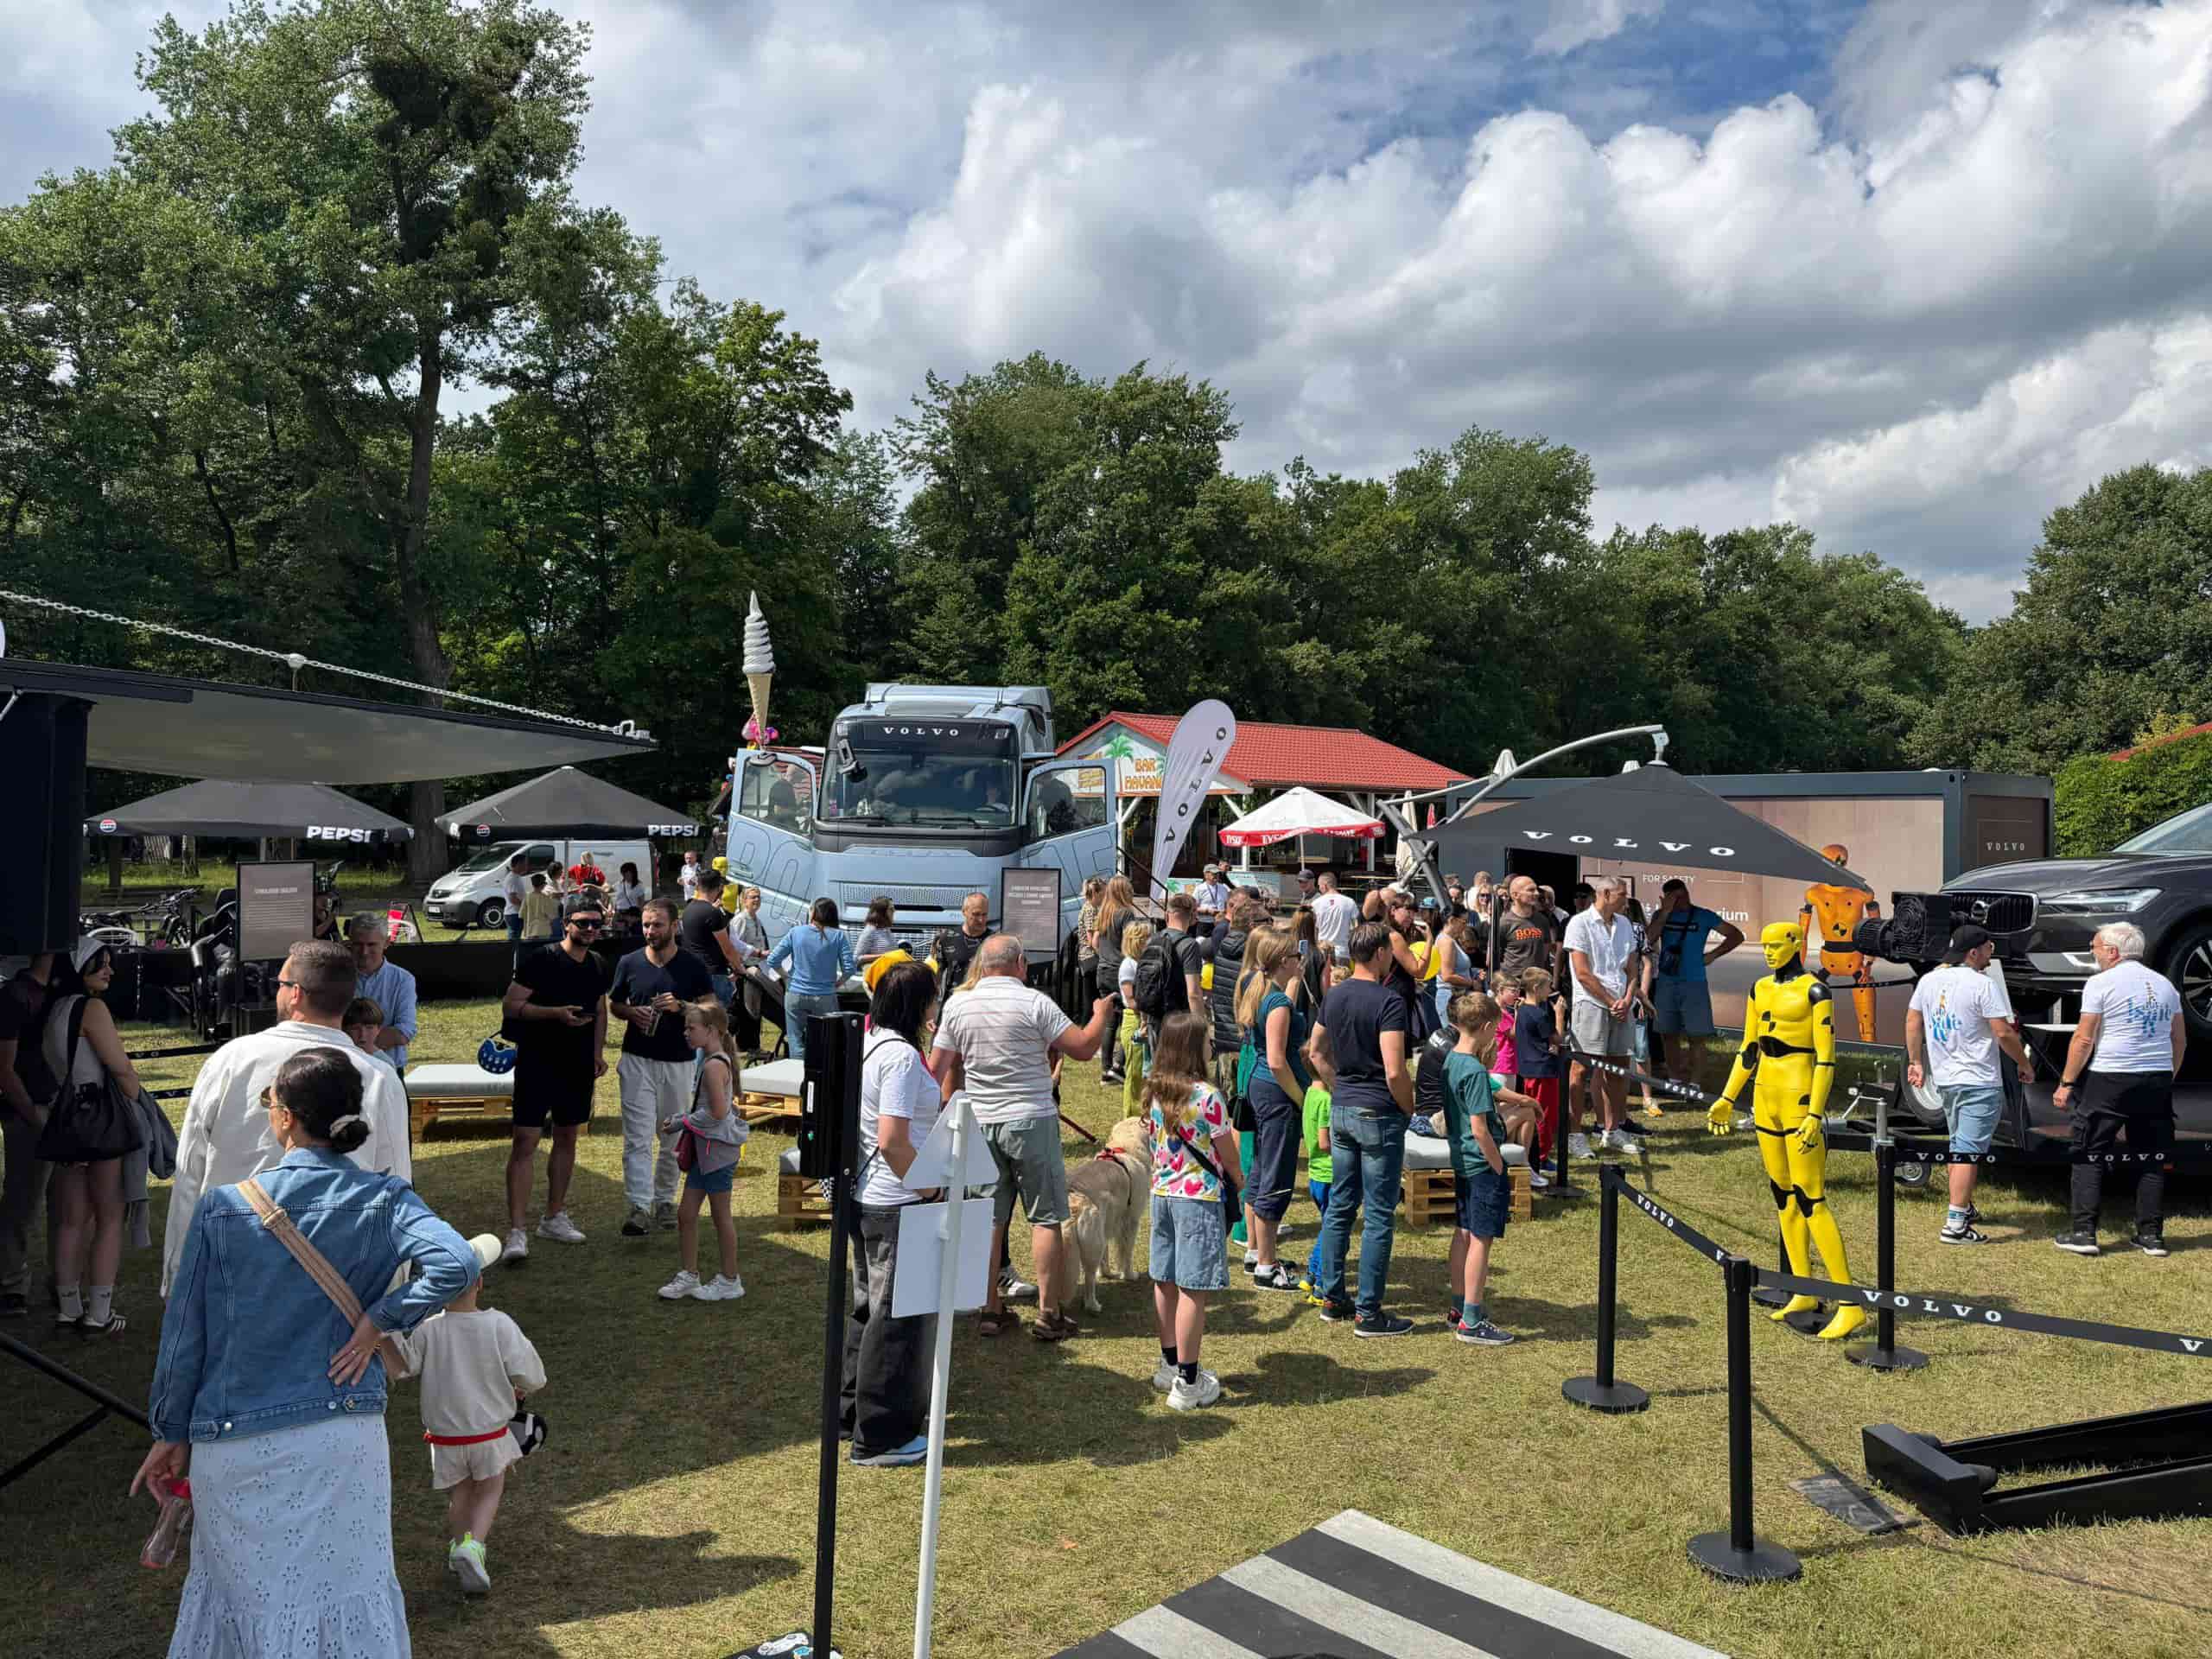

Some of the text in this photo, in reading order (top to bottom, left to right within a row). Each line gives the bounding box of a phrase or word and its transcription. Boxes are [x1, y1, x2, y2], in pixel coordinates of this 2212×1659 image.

[883, 727, 959, 736] VOLVO
[1125, 776, 1162, 790] HAVAN
[1163, 727, 1227, 844] VOLVO
[307, 825, 372, 843] PEPSI
[648, 824, 699, 837] PEPSI
[1522, 830, 1736, 857] VOLVO
[1986, 842, 2025, 851] VOLVO
[1591, 1058, 1625, 1076] VOLVO
[1664, 1082, 1705, 1099] VOLVO
[1916, 1152, 2164, 1164] VOLVO VOLVO
[1637, 1194, 1674, 1227] VOLVO
[1862, 1289, 2003, 1323] VOLVO
